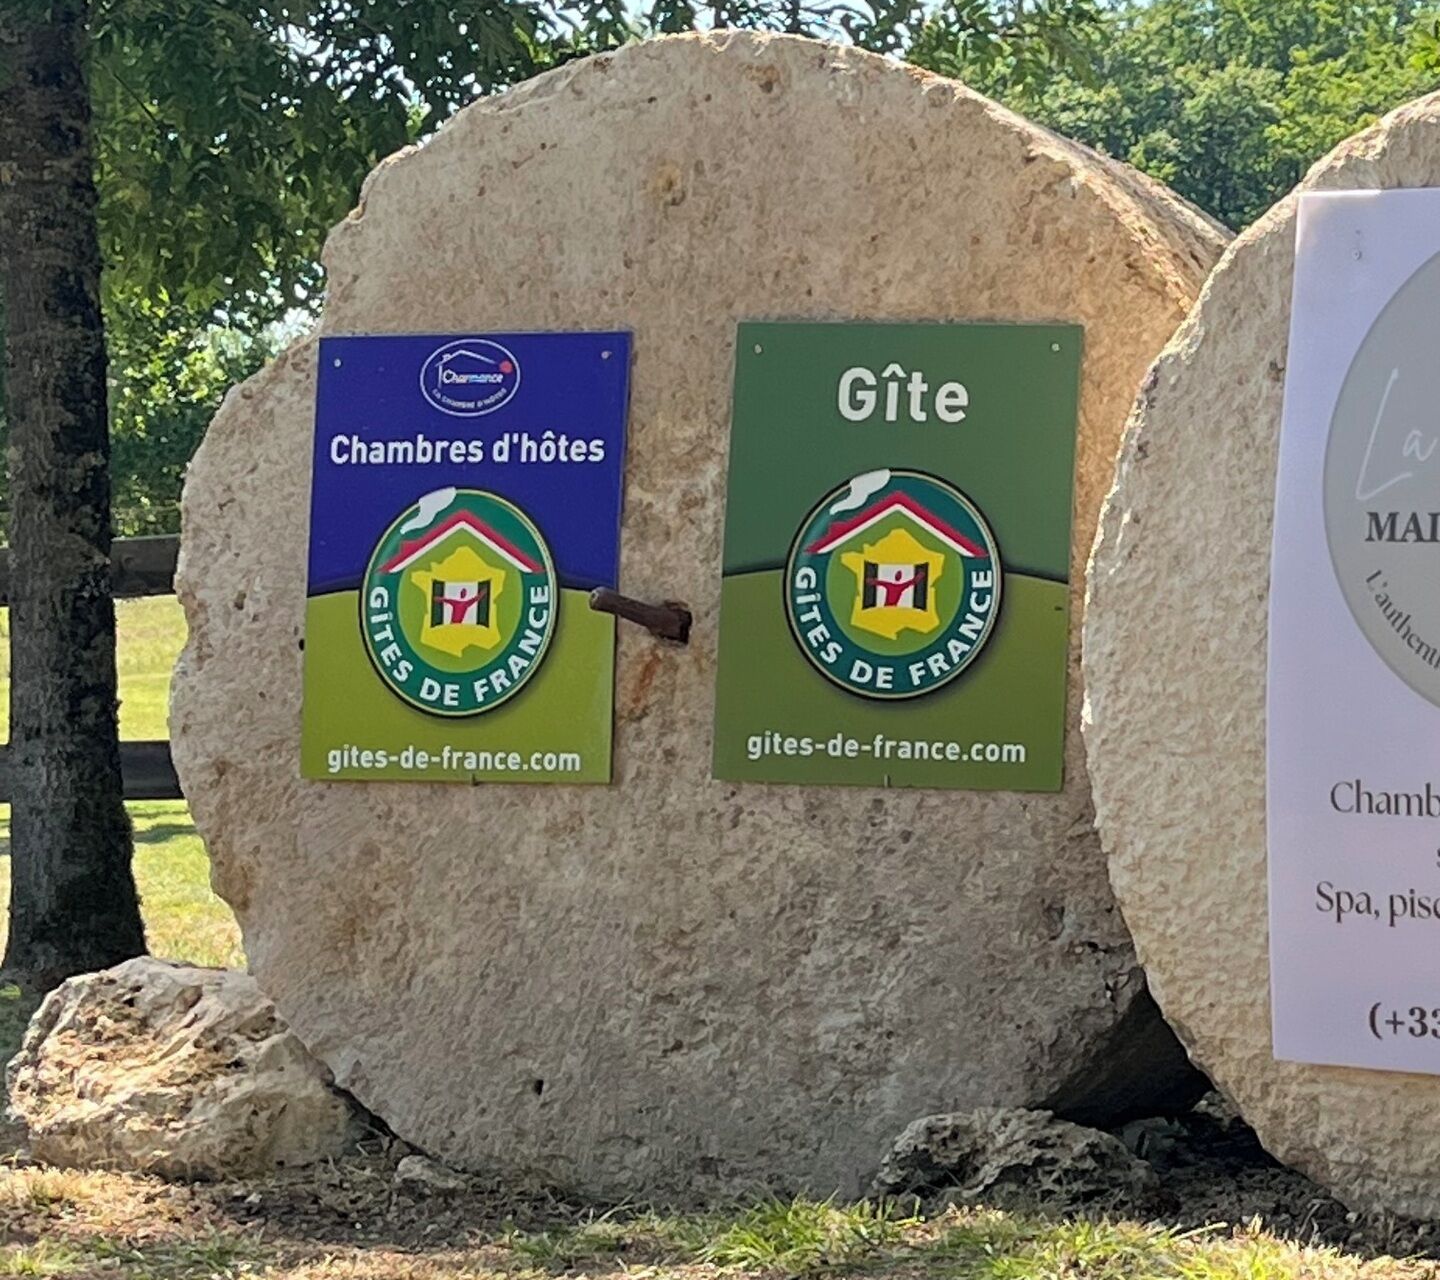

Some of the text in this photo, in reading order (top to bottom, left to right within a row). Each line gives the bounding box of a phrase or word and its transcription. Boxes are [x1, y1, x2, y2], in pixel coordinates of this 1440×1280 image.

[837, 363, 969, 423] Gîte
[331, 431, 605, 464] Chambres d'hôtes
[1355, 367, 1438, 501] La
[370, 585, 549, 706] GÎTES DE FRANCE
[795, 567, 993, 689] GÎTES DE FRANCE
[327, 744, 580, 773] gites-de-france.com
[747, 731, 1026, 762] gites-de-france.com
[1315, 881, 1381, 924] Spa,
